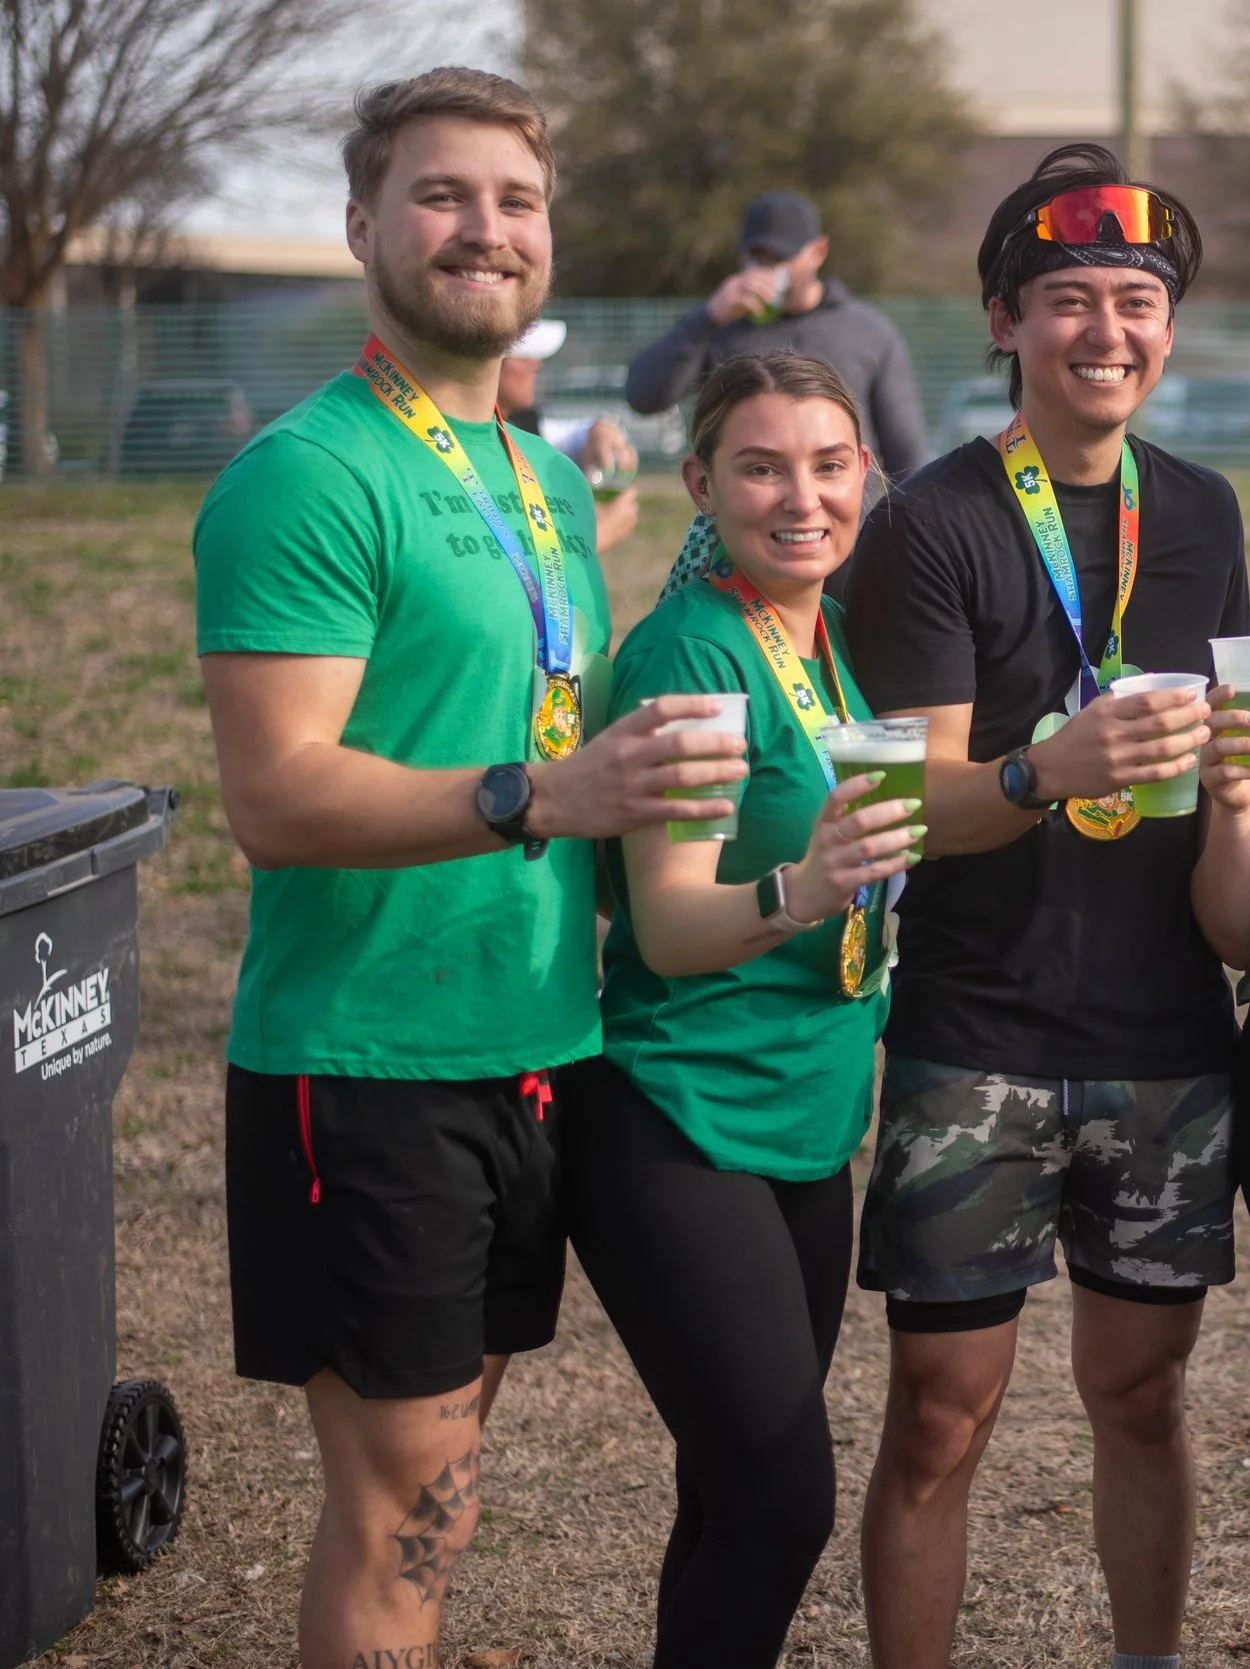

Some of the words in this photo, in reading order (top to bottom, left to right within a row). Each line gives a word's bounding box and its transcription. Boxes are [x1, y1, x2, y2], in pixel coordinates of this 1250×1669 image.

[392, 394, 416, 419] RUN
[433, 431, 451, 449] 5K
[1022, 472, 1035, 489] 5K
[1043, 507, 1059, 532] RUN
[446, 532, 481, 558] to
[550, 547, 562, 571] RUN
[1052, 533, 1076, 601] SHAMROCK
[556, 576, 569, 646] SHAMROCK
[769, 645, 786, 669] RUN
[20, 1008, 107, 1066] TEXAS
[41, 1056, 72, 1081] Unique
[73, 1046, 85, 1064] by
